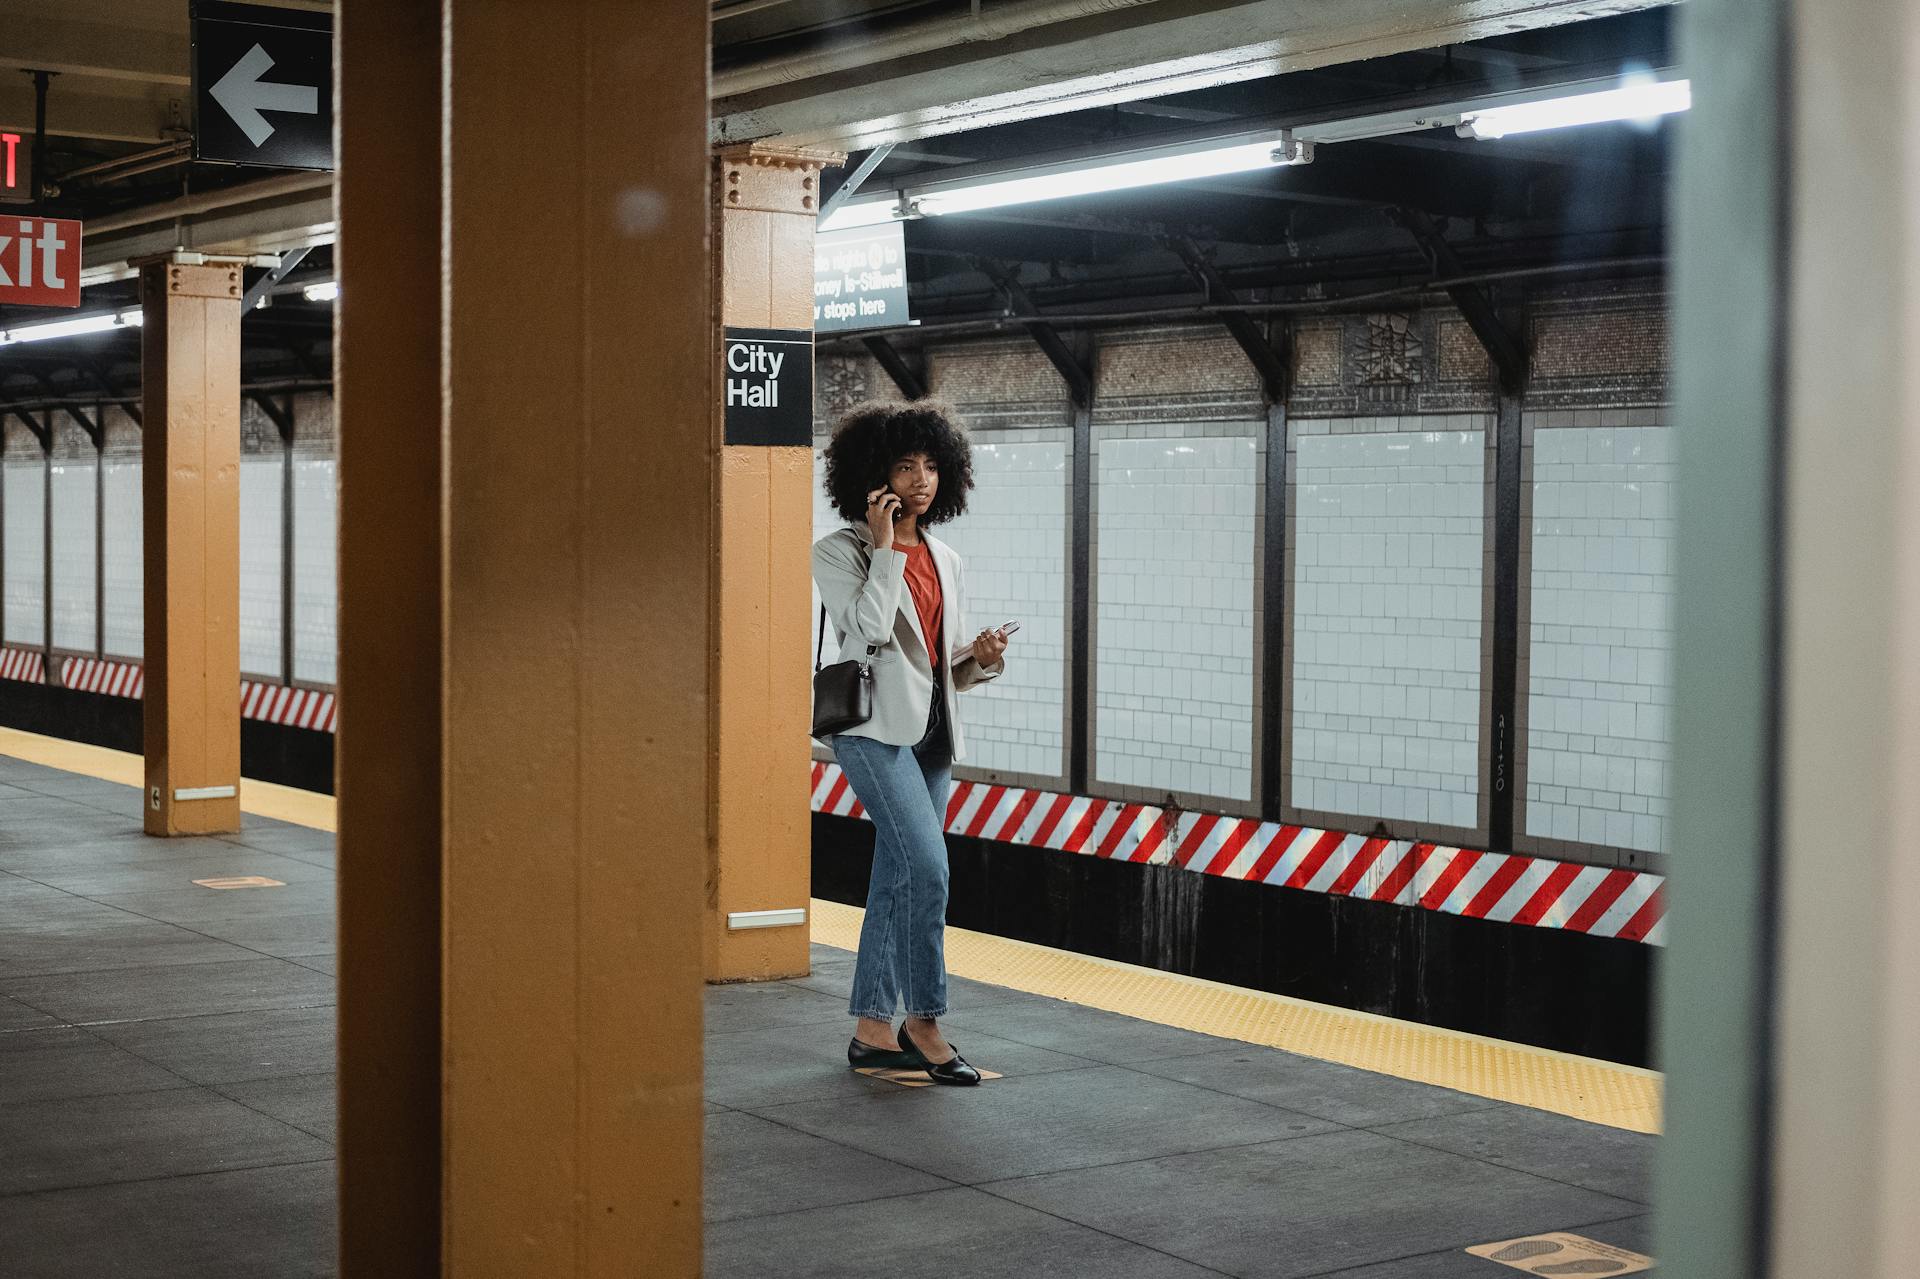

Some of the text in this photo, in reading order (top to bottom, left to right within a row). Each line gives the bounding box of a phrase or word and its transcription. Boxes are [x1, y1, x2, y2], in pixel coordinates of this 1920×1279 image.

[814, 280, 841, 297] oney
[824, 301, 856, 321] stops
[859, 297, 886, 316] here
[727, 343, 784, 379] City
[727, 379, 778, 407] Hall
